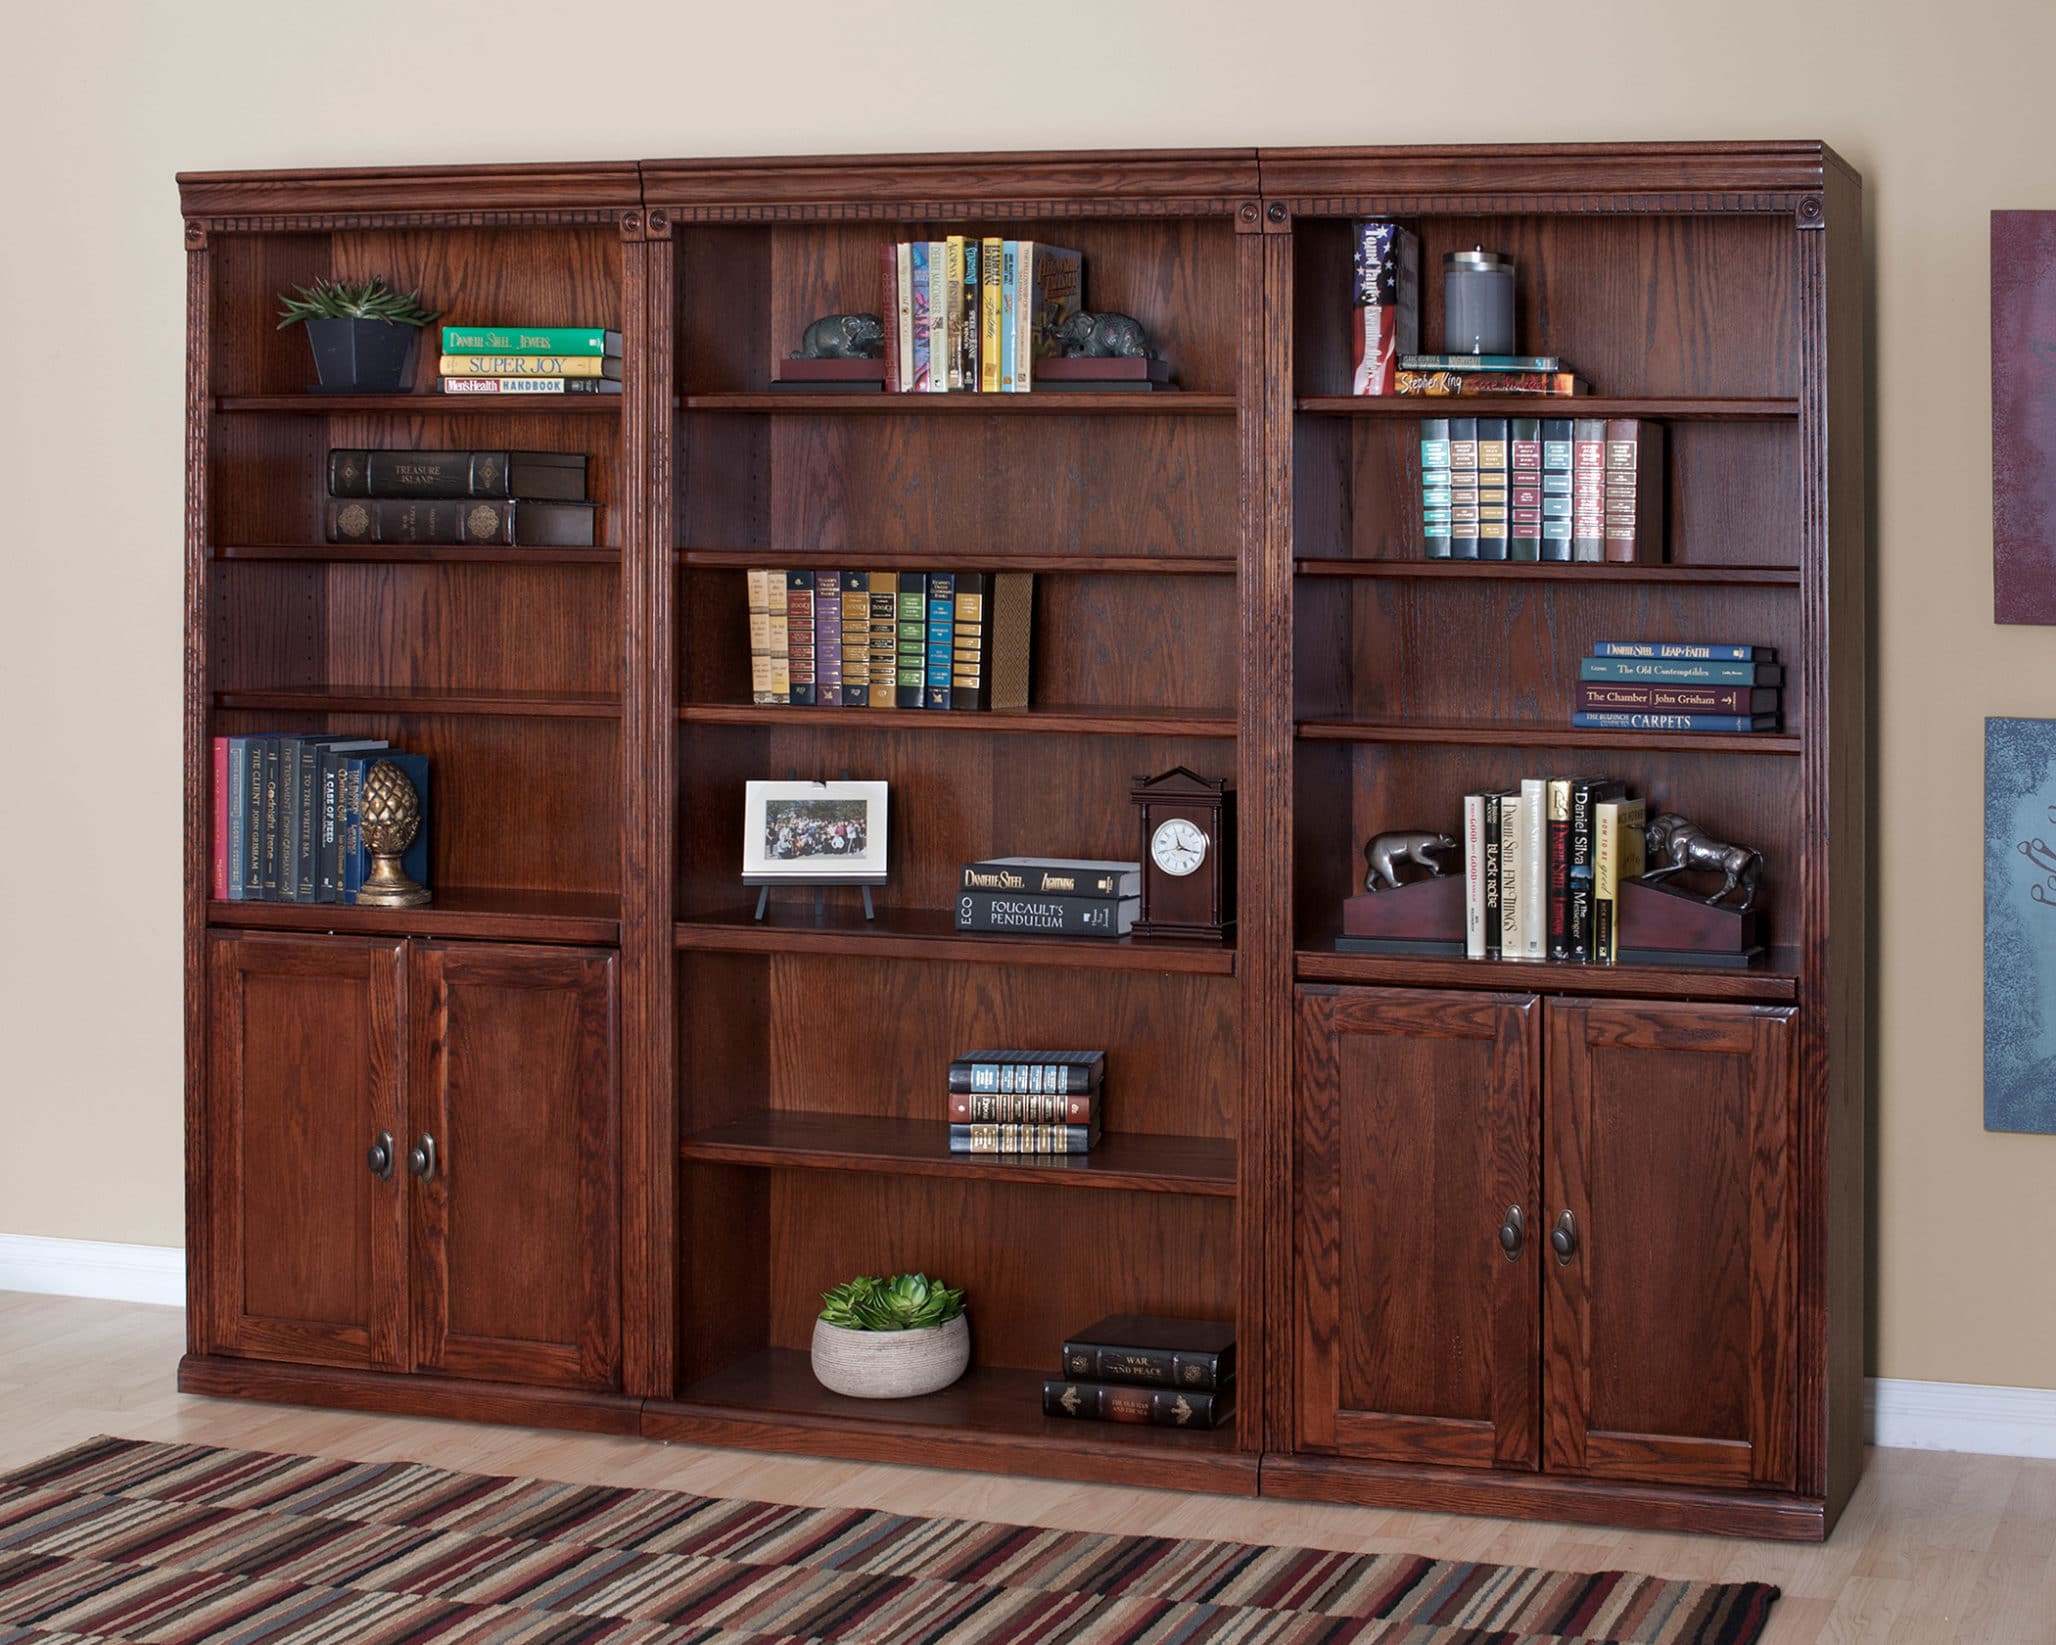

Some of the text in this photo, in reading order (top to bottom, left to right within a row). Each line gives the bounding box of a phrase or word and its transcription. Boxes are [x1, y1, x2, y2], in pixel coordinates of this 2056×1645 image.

[984, 245, 992, 286] ROBBINS
[992, 245, 1000, 286] HAROLD
[1363, 229, 1382, 304] Tom Clancy
[469, 357, 567, 374] SUPER JOY
[502, 381, 561, 391] HANDBOOK
[1401, 372, 1462, 395] Stephen King
[395, 465, 440, 476] TREASURE
[402, 475, 433, 484] ISLAND
[1685, 646, 1710, 657] FAITH
[1617, 664, 1634, 674] The
[1636, 665, 1652, 675] Old
[1586, 691, 1715, 705] The Chamber John Grisham
[1631, 714, 1692, 729] CARPETS
[253, 770, 261, 806] CLIENT
[326, 781, 334, 805] CASE
[252, 809, 260, 830] JOHN
[266, 781, 276, 860] Goodnight, Irene
[303, 774, 311, 858] TO THE WHITE SEA
[326, 806, 334, 818] OF
[326, 820, 334, 844] NEED
[1470, 818, 1478, 843] GOOD
[1575, 792, 1588, 865] Daniel Silva
[252, 831, 260, 870] GRISHAM
[1601, 839, 1607, 848] TO
[1601, 851, 1607, 861] BE
[1470, 855, 1478, 881] GOOD
[1487, 843, 1498, 908] BLACK ROBE
[1503, 803, 1518, 932] DANIELLE STEEL FINE THINGS
[965, 869, 1075, 891] DANIELLE STEEL LIGHTNING
[1597, 864, 1612, 895] good
[962, 897, 972, 925] ECO
[991, 901, 1063, 915] FOUCAULT'S
[1572, 891, 1586, 939] Messenger
[1579, 906, 1588, 918] The
[991, 913, 1063, 928] PENDULUM
[1126, 1356, 1148, 1365] WAR
[1133, 1367, 1161, 1376] PEACE
